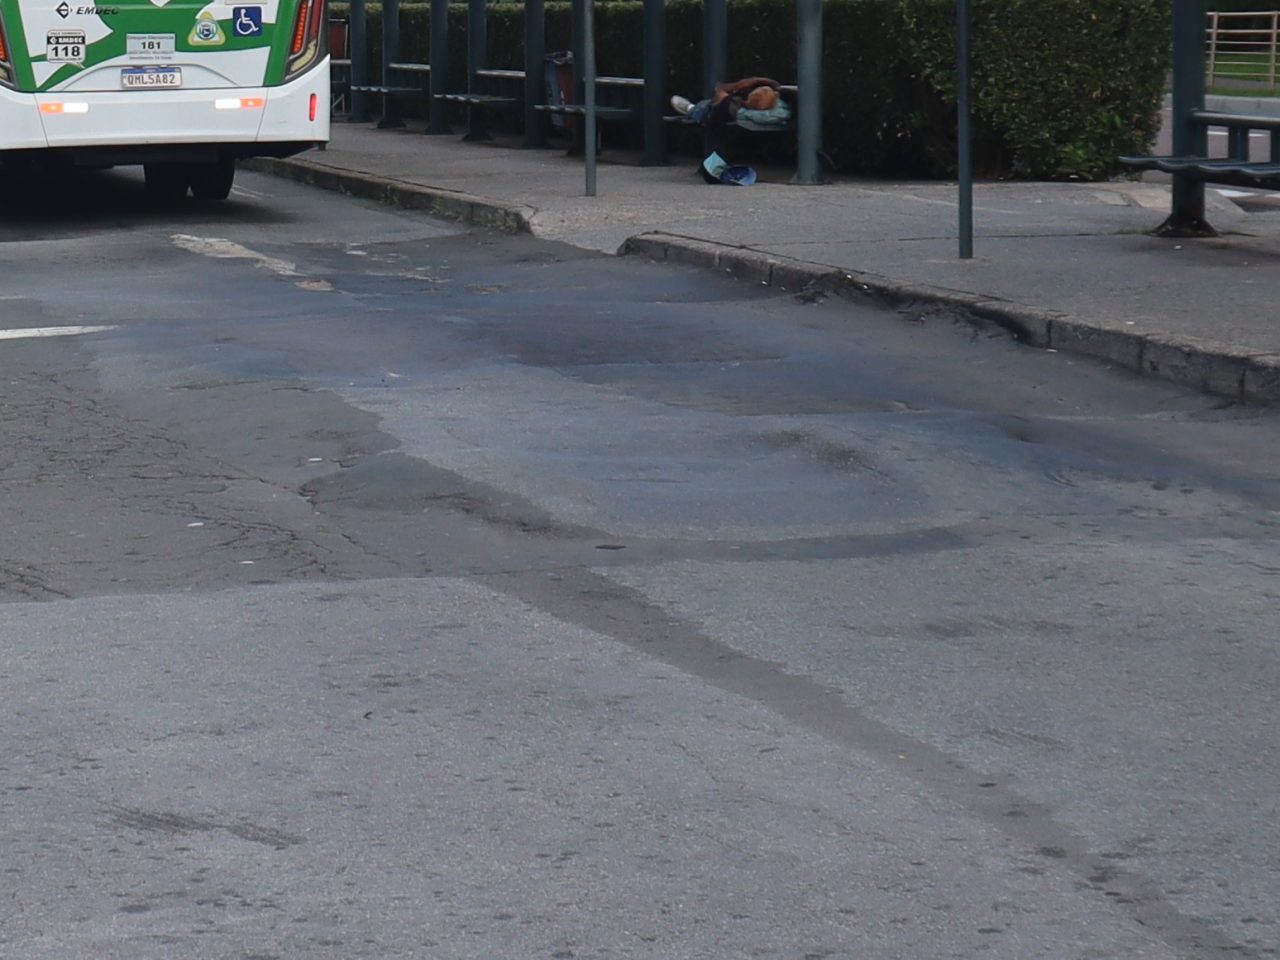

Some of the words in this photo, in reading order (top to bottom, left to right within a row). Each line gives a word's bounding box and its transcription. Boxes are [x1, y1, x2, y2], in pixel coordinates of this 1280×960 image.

[76, 6, 120, 16] EMDEC
[140, 41, 161, 50] 181
[51, 45, 80, 57] 118
